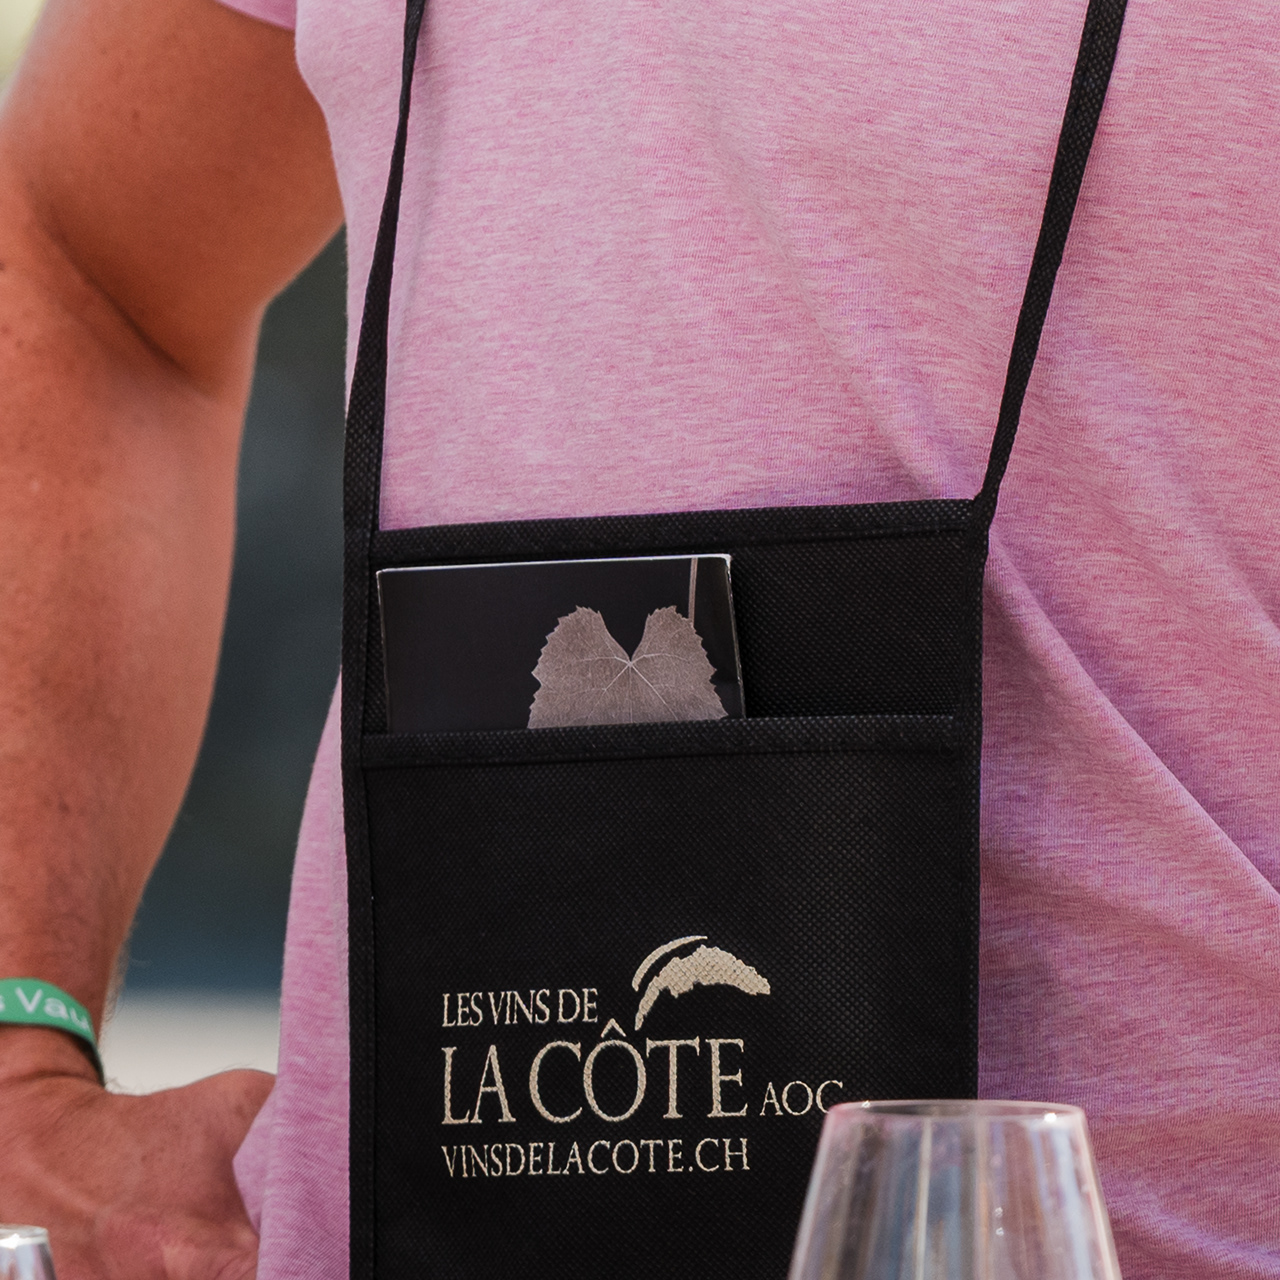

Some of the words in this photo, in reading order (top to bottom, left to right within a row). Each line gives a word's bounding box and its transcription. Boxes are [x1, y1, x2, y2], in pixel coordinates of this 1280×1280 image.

[441, 991, 484, 1027] LES
[487, 988, 551, 1025] VINS
[556, 987, 599, 1023] DE
[441, 1044, 517, 1125] LA
[528, 1017, 749, 1124] CÔTE
[759, 1080, 844, 1117] AOC
[441, 1137, 751, 1178] VINSDELACOTE.CH
